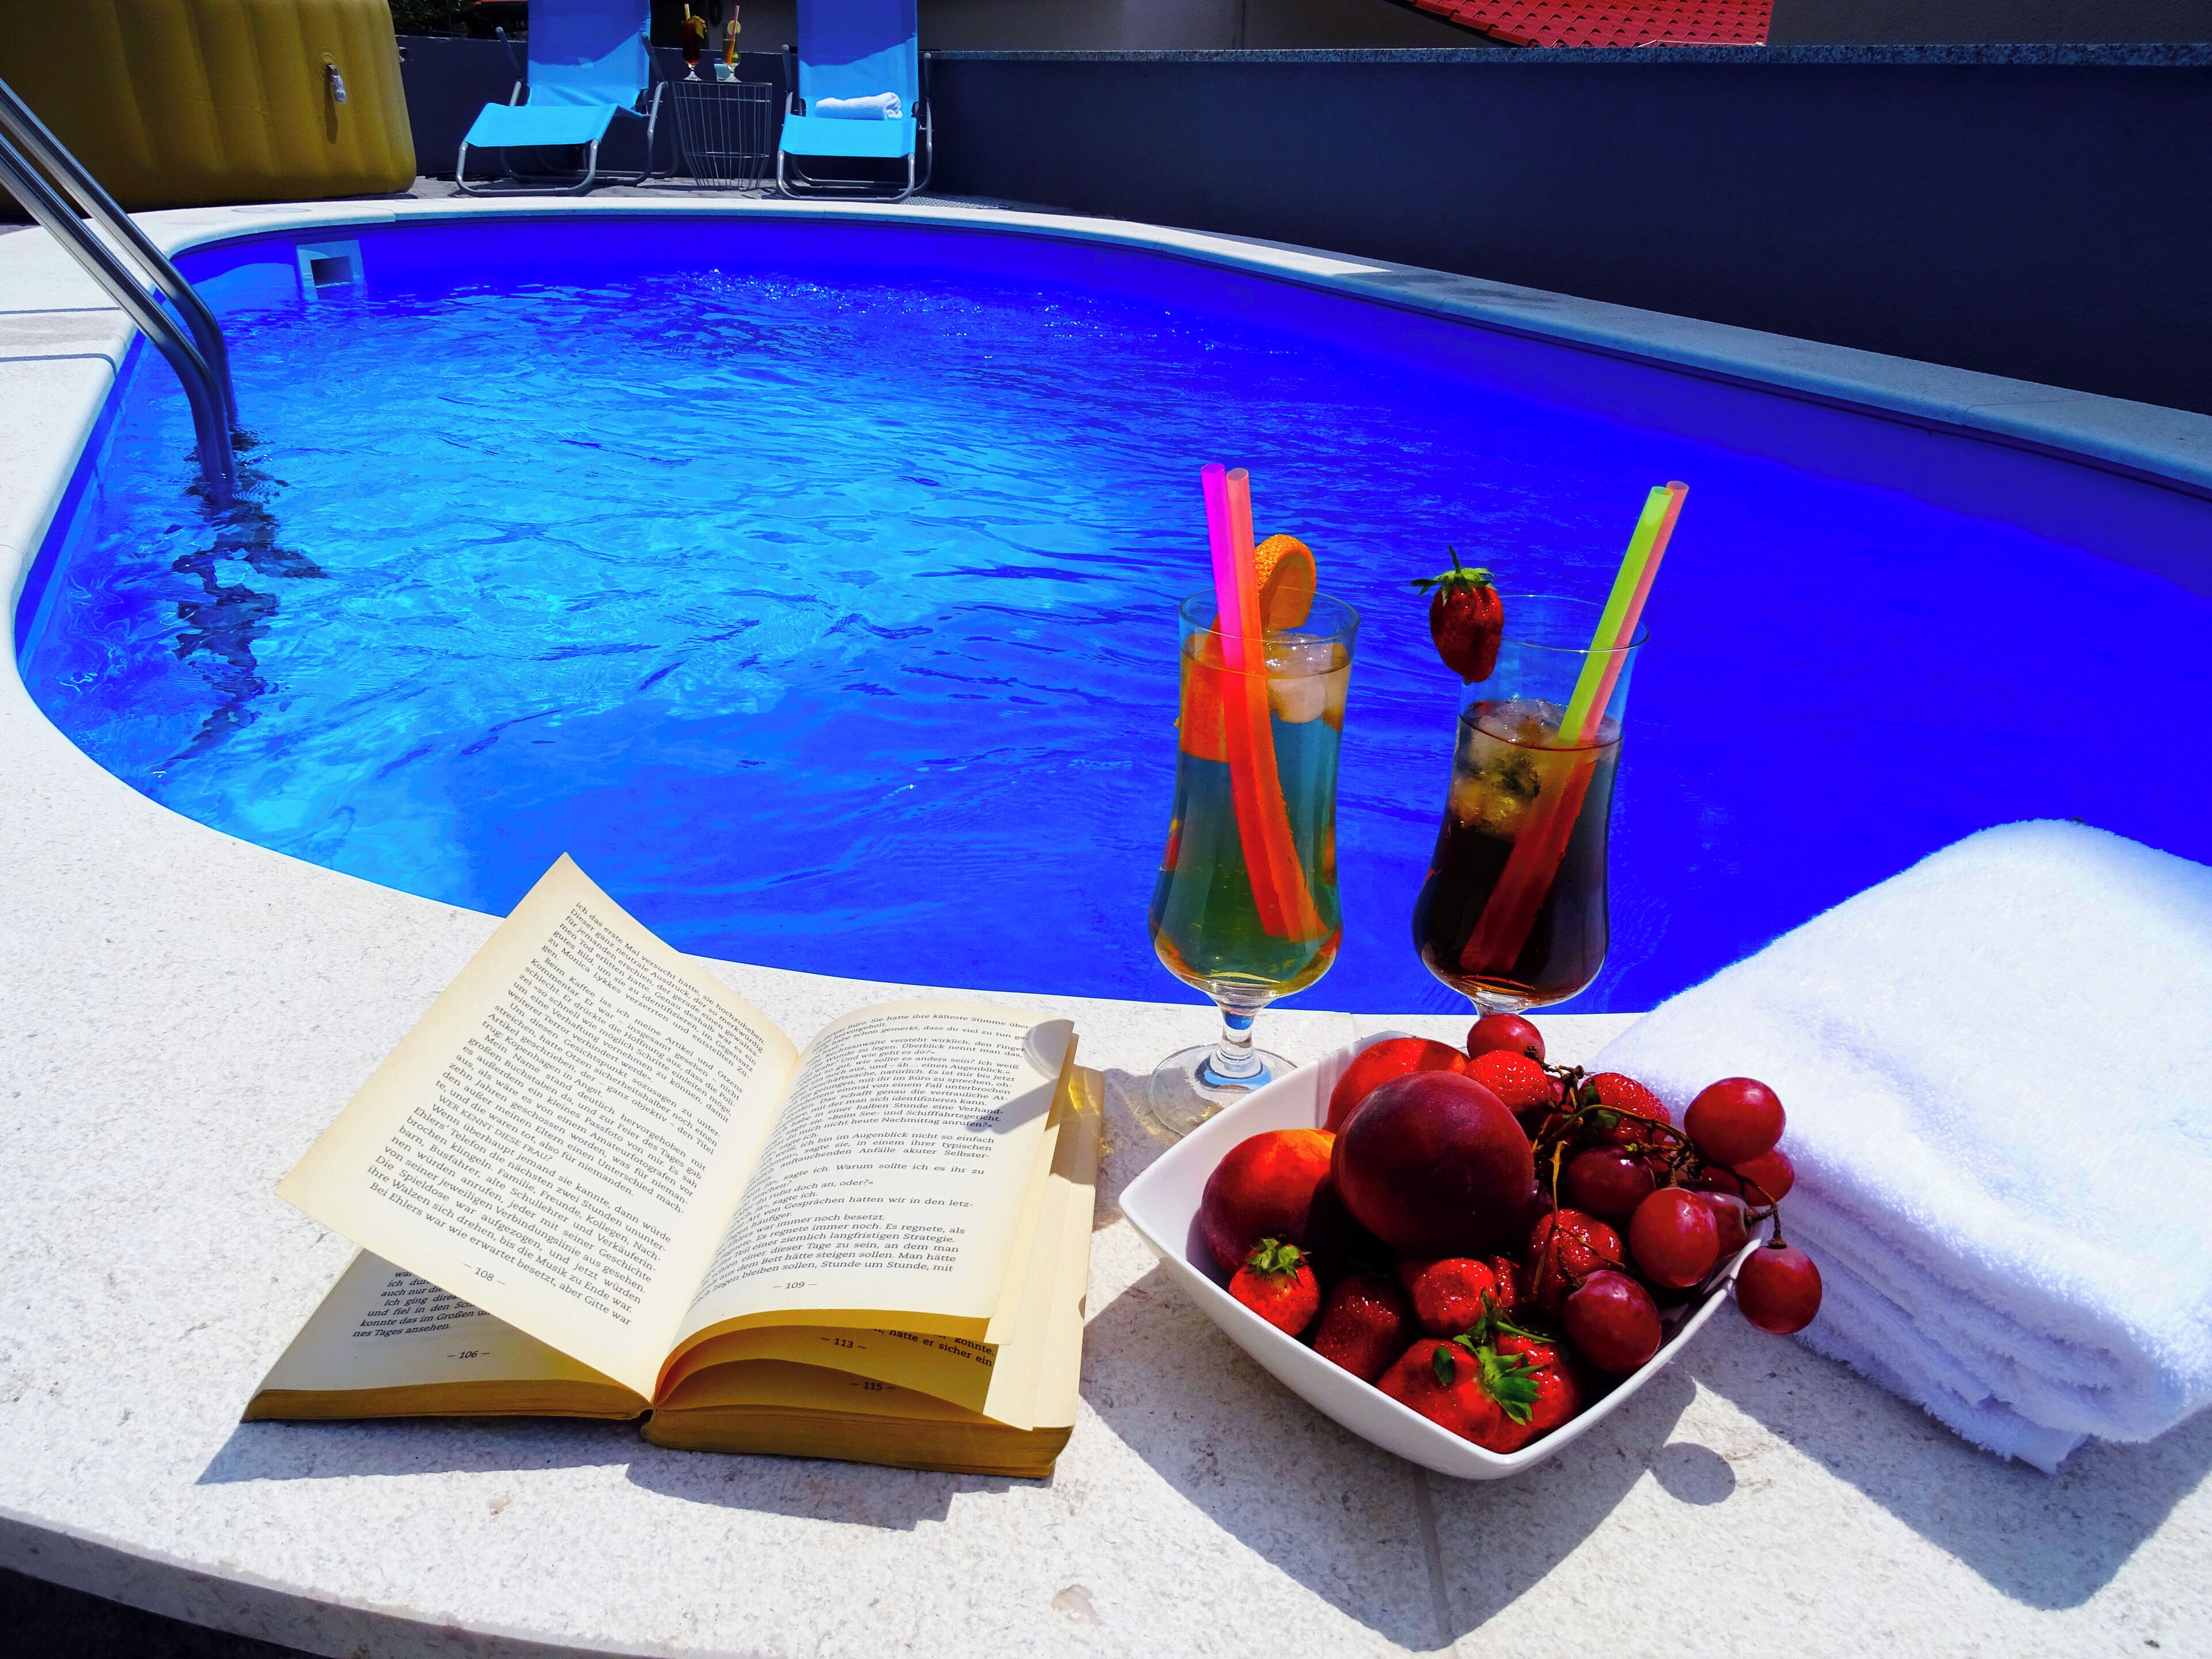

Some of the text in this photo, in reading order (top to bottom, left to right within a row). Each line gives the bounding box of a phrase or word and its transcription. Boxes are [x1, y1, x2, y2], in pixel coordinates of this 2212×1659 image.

[575, 902, 764, 1045] ich das erste Mal versucht hatte, sie hochzuheben.
[544, 957, 743, 1093] Beim Kaffee las ich meine Artikel und Otzens
[996, 1044, 1025, 1052] Finger
[482, 1021, 602, 1097] trug: Kopenhagen in Angst.
[494, 1005, 717, 1146] streichen, hatte Otzen sicherheitshalber noch einen
[484, 1034, 706, 1171] Mein Name stand deutlich hervorgehoben mit
[810, 1104, 826, 1112] mit
[439, 1094, 553, 1161] WER KENNT DIESE FRAU?
[456, 1054, 694, 1196] aus, als wäre es von einem Amateurfotografen vor
[785, 1123, 807, 1135] sagte
[906, 1109, 1001, 1121] Schifffahrtsgericht.
[780, 1149, 851, 1168] auftauchenden
[944, 1150, 988, 1158] Selbster-
[433, 1103, 671, 1243] Wenn überhaupt jemand sie kannte, dann würde
[399, 1124, 656, 1270] barn, Busfahrer, alte Schullehrer und Verkäuferin-
[406, 1115, 660, 1260] brochen klingeln. Familie, Freunde, Kollegen, Nach-
[764, 1206, 781, 1215] von
[784, 1197, 844, 1209] Gesprächen
[756, 1224, 775, 1233] war
[776, 1217, 812, 1227] immer
[752, 1231, 955, 1250] einer ziemlich langfristigen Strategie.
[369, 1181, 631, 1325] Bei Ehlers war wie erwartet besetzt, aber Gitte war
[475, 1267, 494, 1281] 108
[741, 1266, 779, 1278] bleiben
[782, 1262, 817, 1270] sollen,
[886, 1261, 929, 1270] Stunde,
[368, 1309, 389, 1317] und
[393, 1308, 411, 1316] fiel
[431, 1304, 449, 1312] den
[404, 1297, 429, 1306] ging
[359, 1319, 396, 1327] konnte
[437, 1311, 474, 1320] Großen
[374, 1328, 403, 1337] Tages
[405, 1324, 451, 1334] ansehen.
[834, 1338, 854, 1348] 113
[923, 1338, 934, 1347] er
[939, 1342, 972, 1358] sicher
[976, 1355, 993, 1366] ein
[459, 1350, 479, 1358] 106
[864, 1382, 882, 1391] 115
